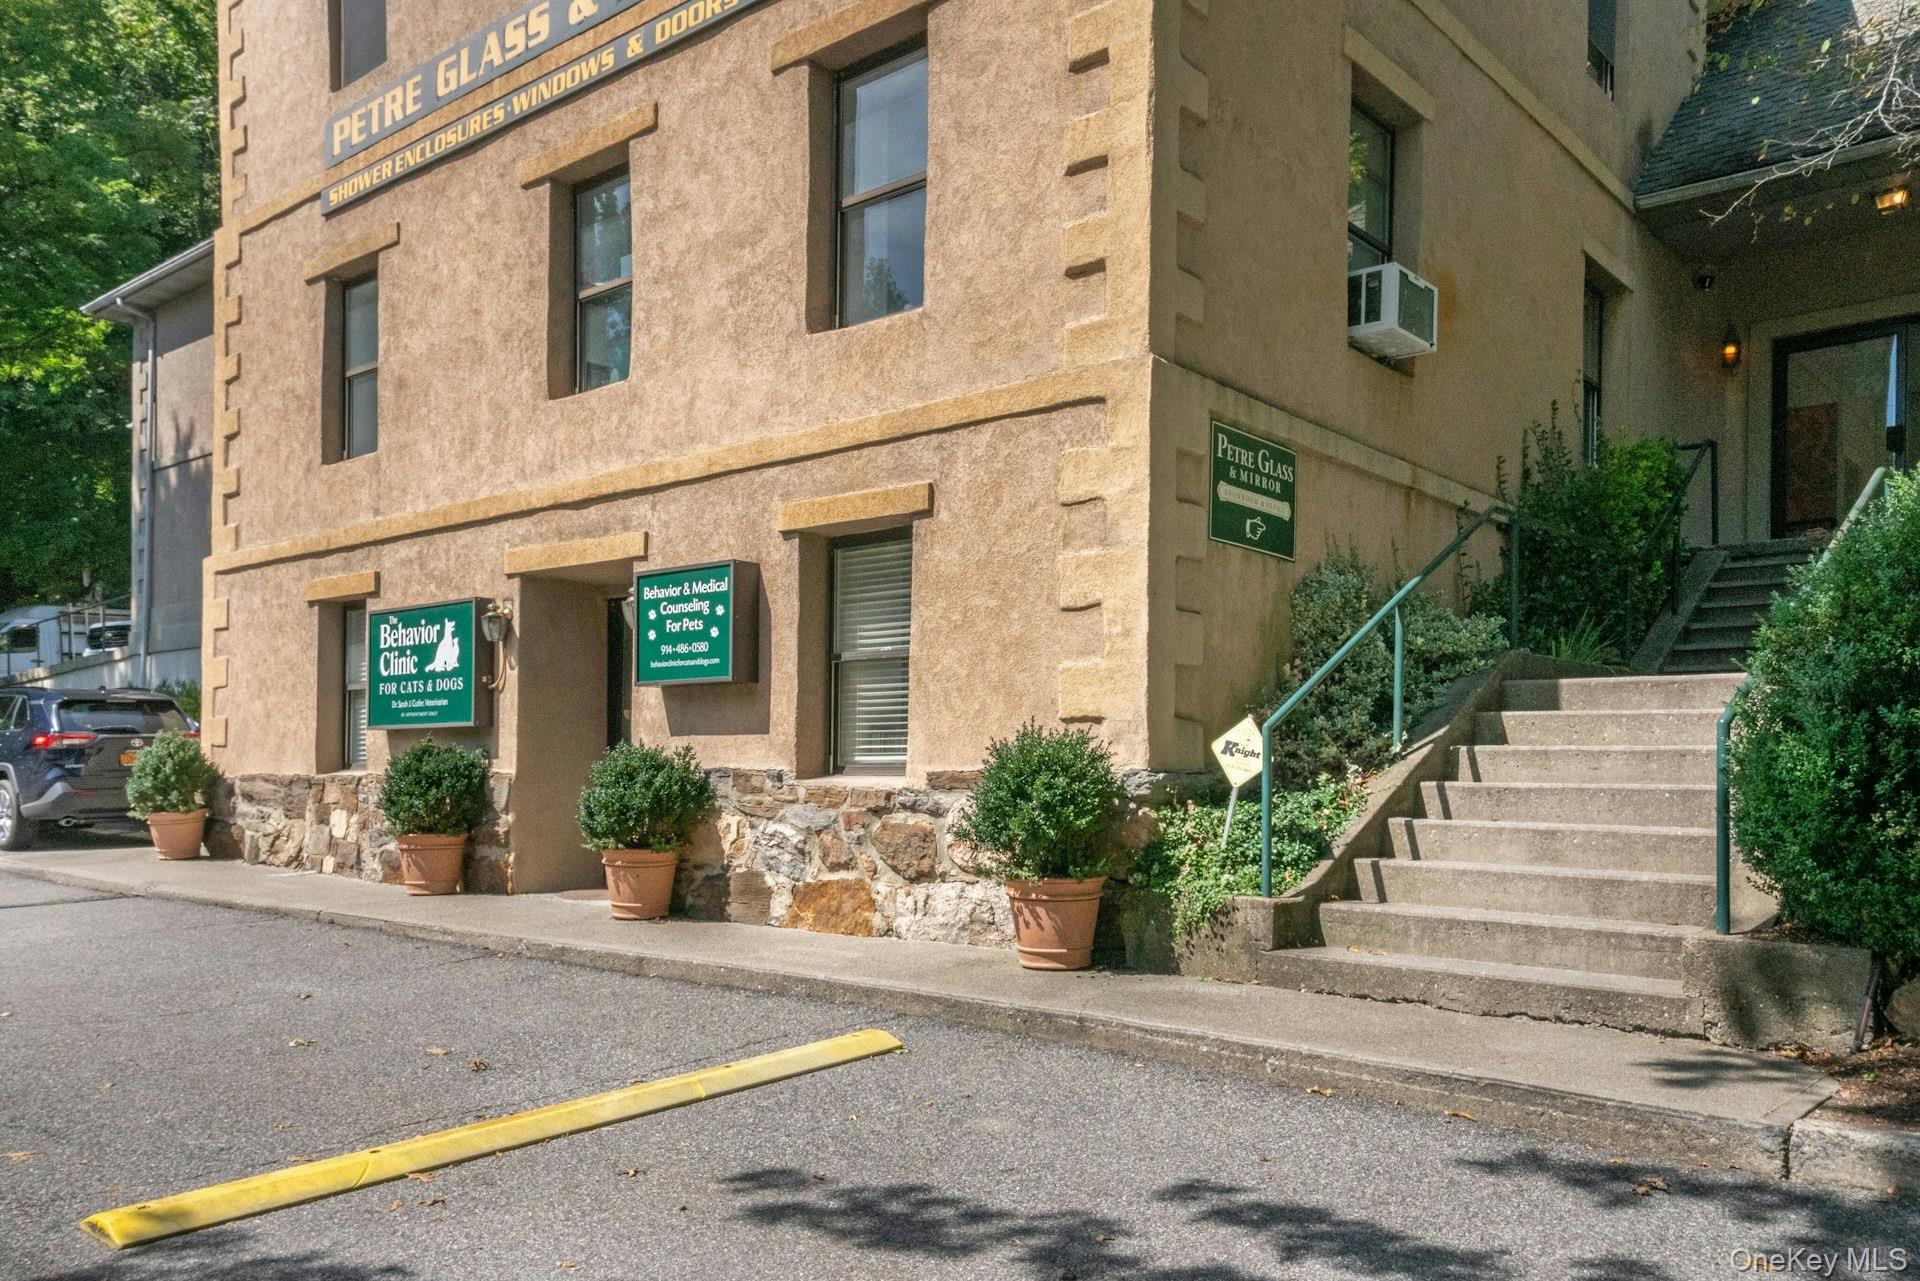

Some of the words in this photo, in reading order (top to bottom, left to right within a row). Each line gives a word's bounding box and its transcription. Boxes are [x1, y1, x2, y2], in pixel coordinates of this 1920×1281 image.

[332, 74, 422, 157] PETRE
[435, 0, 550, 99] GLASS
[329, 161, 393, 206] SHOWER
[626, 33, 644, 59] &
[1216, 433, 1255, 469] PETRE
[1258, 449, 1294, 483] GLASS
[1229, 466, 1237, 479] &
[1239, 468, 1281, 494] MIRROR
[643, 584, 682, 600] Behavior
[683, 582, 690, 595] &
[692, 577, 728, 594] Medical
[660, 598, 710, 615] Counseling
[388, 615, 398, 625] The
[666, 619, 682, 633] For
[683, 618, 704, 632] Pets
[380, 618, 440, 649] Behavior
[380, 649, 418, 677] Clinic
[379, 682, 397, 696] FOR
[400, 680, 424, 695] CATS
[426, 679, 433, 692] &
[436, 677, 464, 690] DOGS
[1221, 739, 1261, 759] Knight
